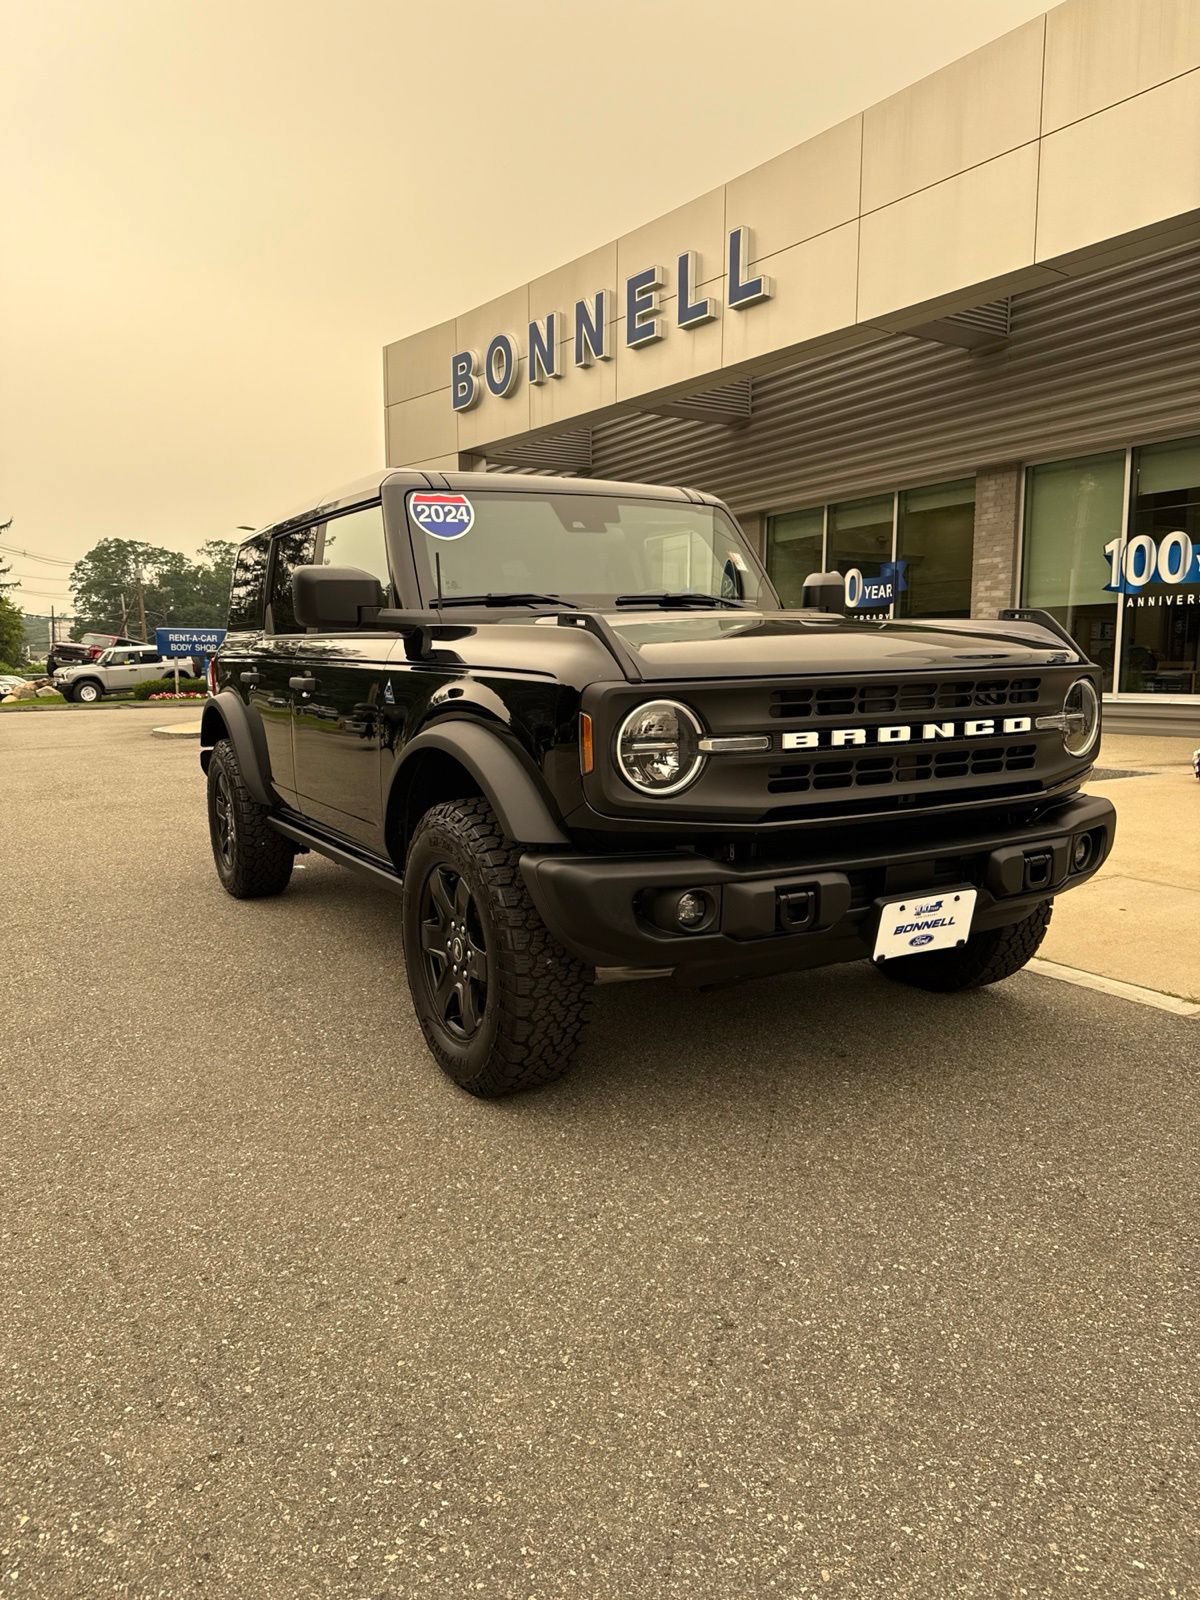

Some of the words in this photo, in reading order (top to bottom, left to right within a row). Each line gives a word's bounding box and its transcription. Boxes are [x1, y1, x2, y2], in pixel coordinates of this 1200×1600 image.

[451, 225, 772, 412] BONNELL
[416, 505, 470, 523] 2024
[1104, 530, 1193, 587] 100
[864, 584, 893, 599] YEAR
[1126, 593, 1200, 608] ANNIVER
[168, 633, 218, 642] RENT-A-CAR
[170, 643, 192, 651] BODY
[782, 717, 1031, 749] BRONCO
[893, 916, 956, 936] BONNELL
